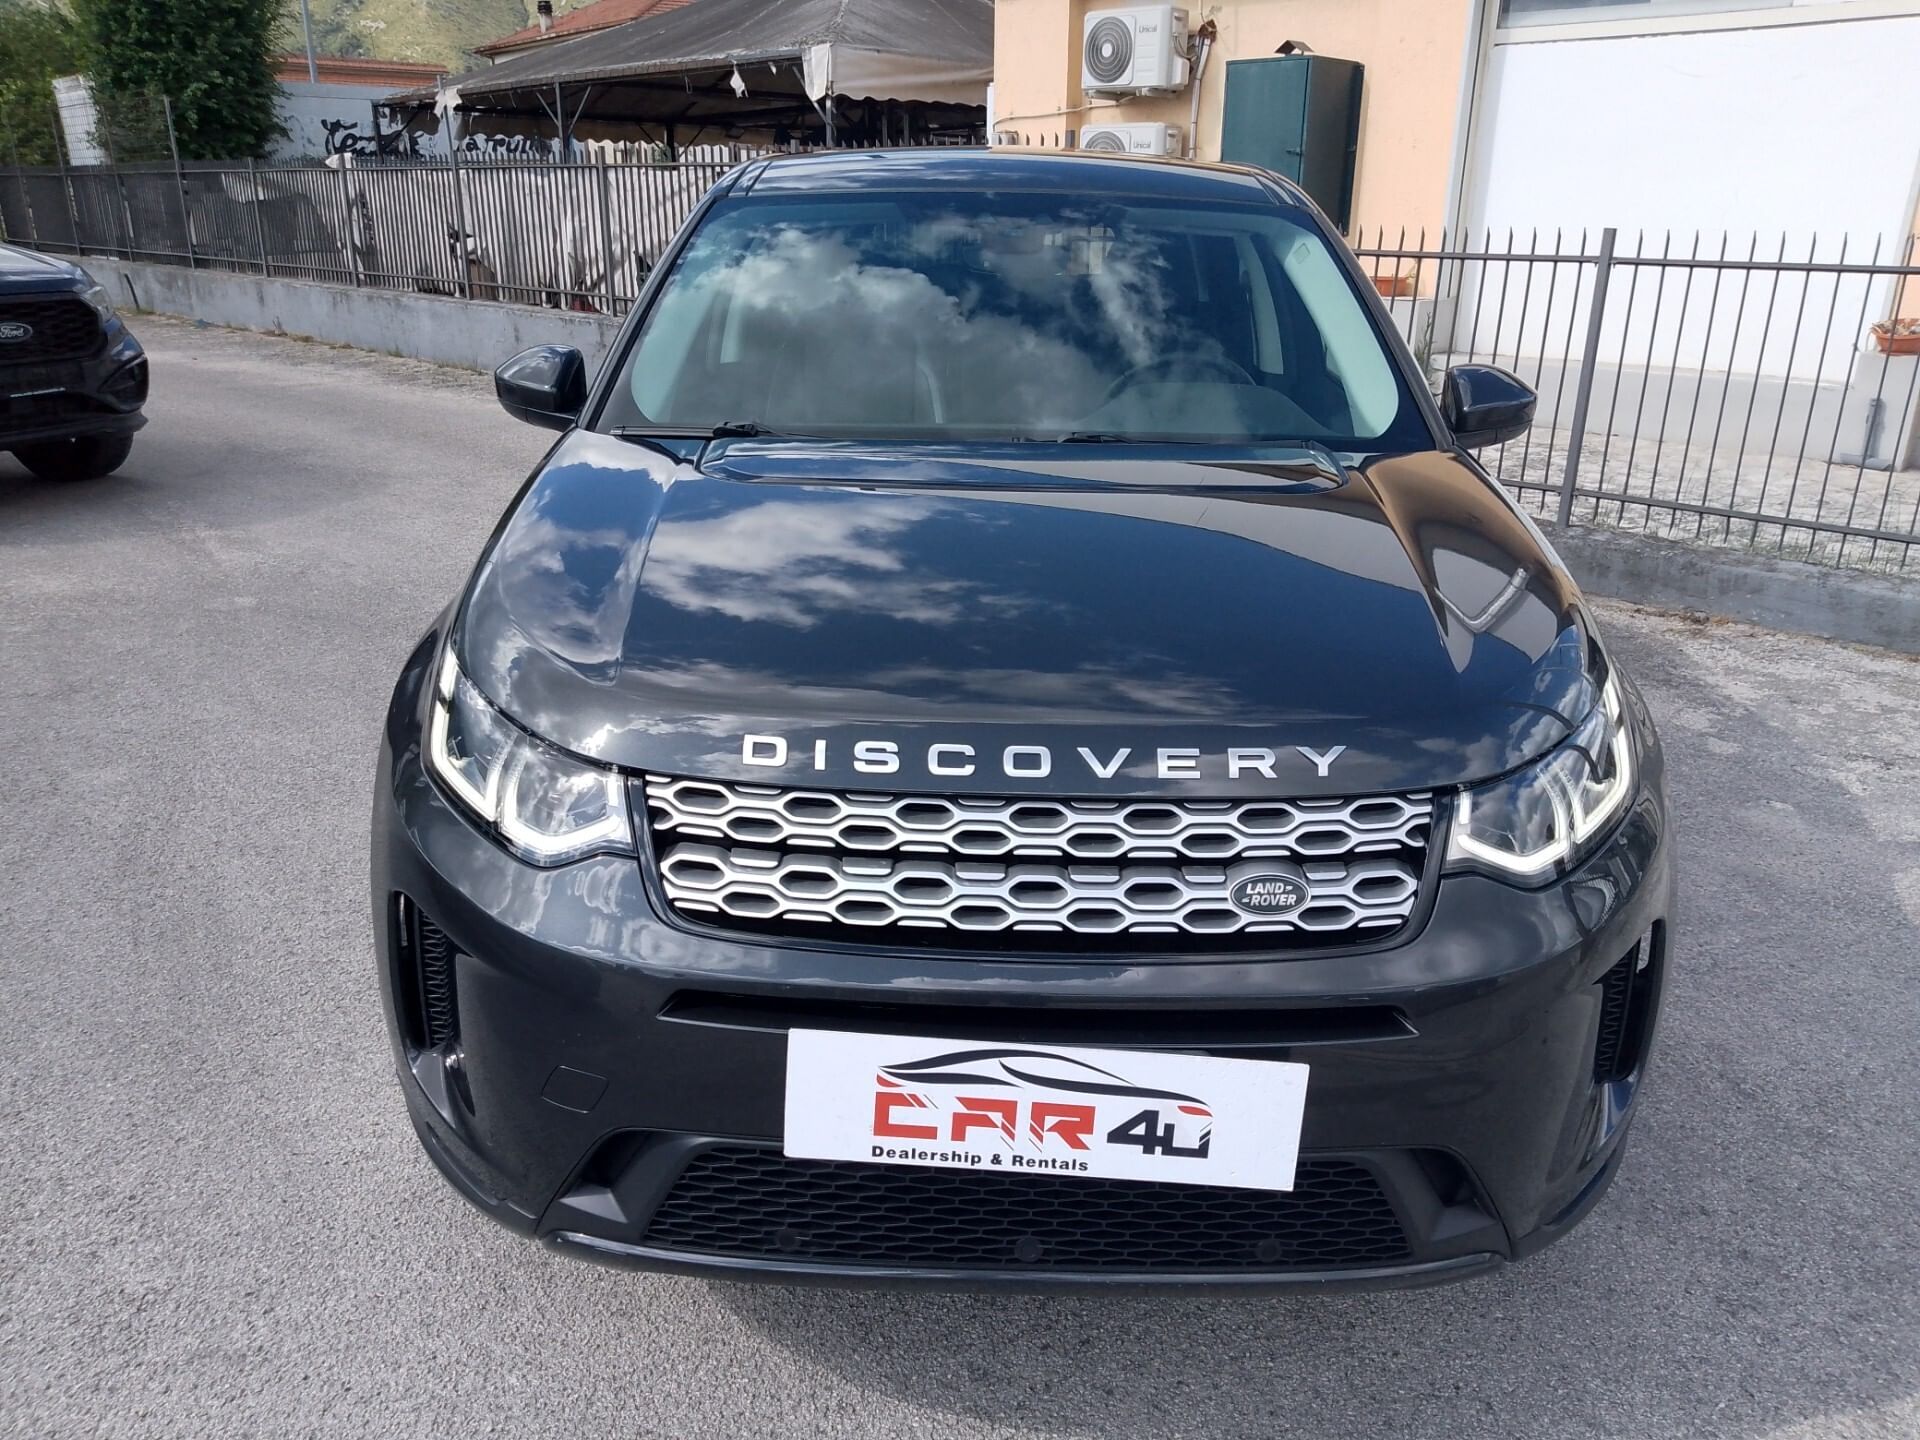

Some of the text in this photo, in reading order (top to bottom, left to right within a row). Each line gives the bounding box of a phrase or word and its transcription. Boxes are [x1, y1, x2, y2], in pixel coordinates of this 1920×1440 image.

[0, 326, 24, 338] Ford
[741, 733, 1347, 779] DISCOVERY
[1246, 882, 1285, 895] LAND
[1250, 894, 1297, 907] ROVER
[873, 1091, 1096, 1152] CAR
[871, 1144, 1090, 1172] Dealership & Rentals
